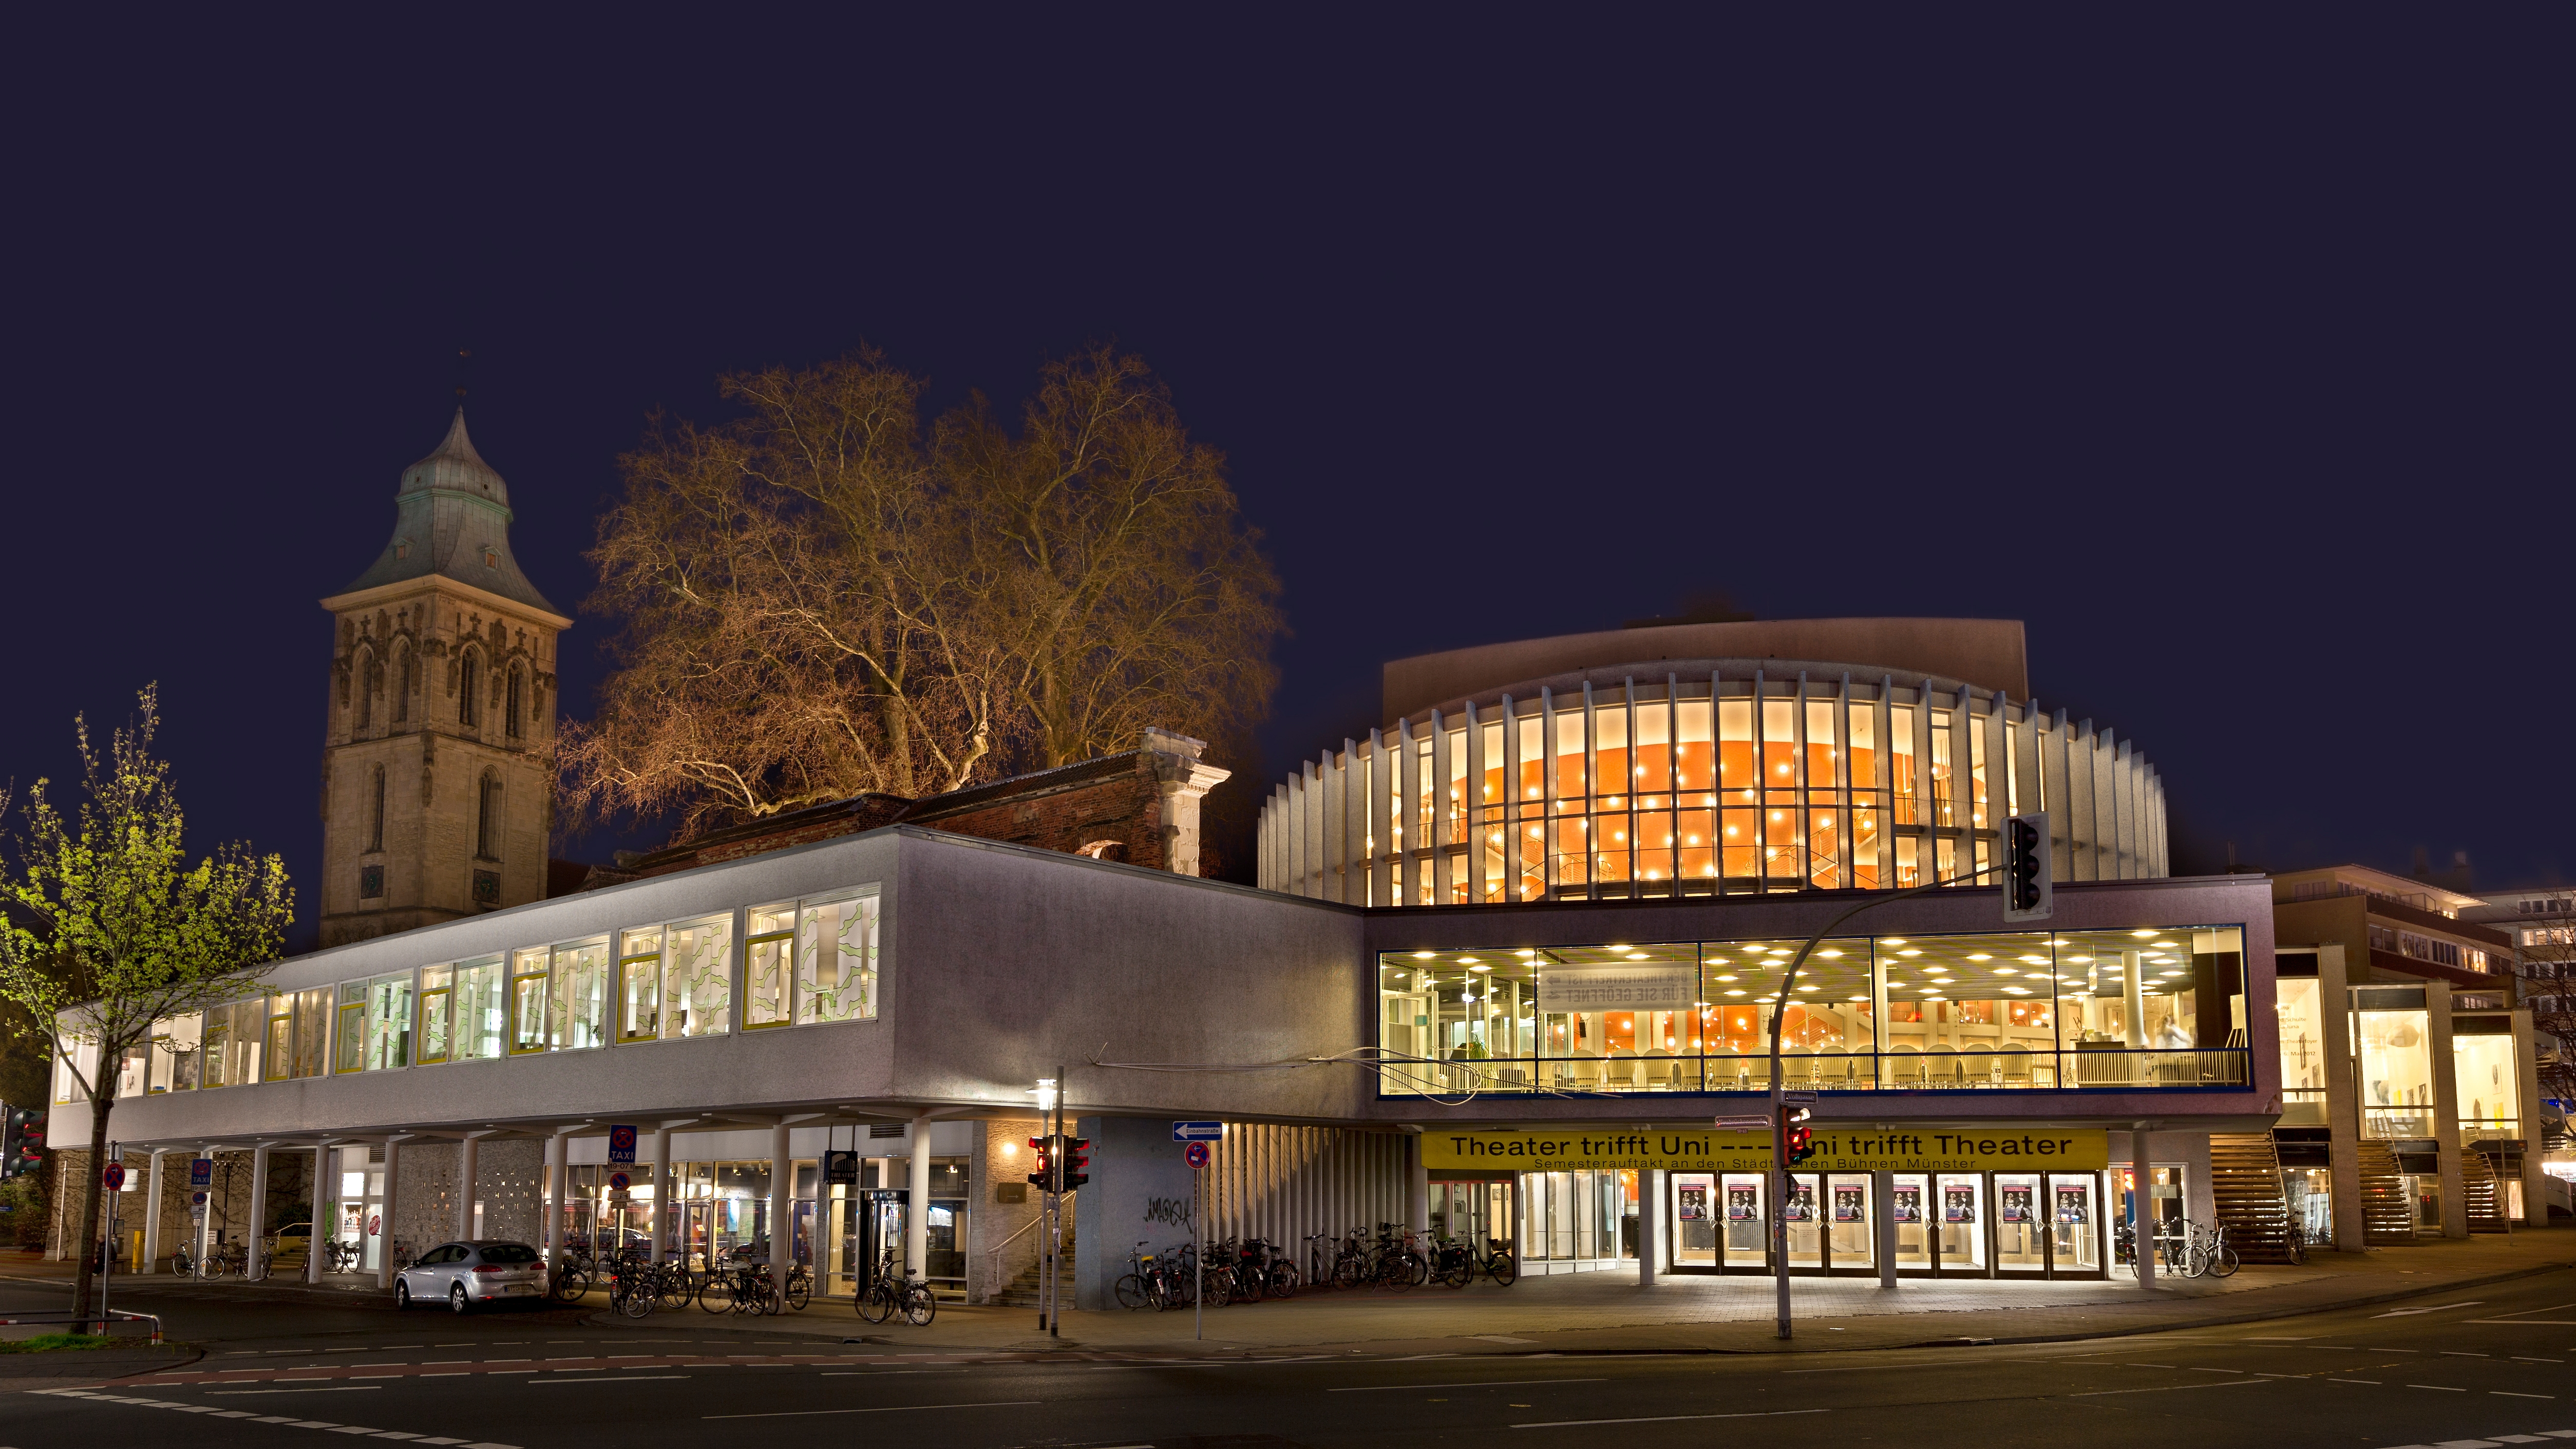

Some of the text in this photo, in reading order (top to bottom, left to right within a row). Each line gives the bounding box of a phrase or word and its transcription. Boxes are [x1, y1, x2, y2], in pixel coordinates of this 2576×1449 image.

[1450, 1137, 1570, 1156] Theater
[1580, 1136, 1649, 1155] trifft
[1661, 1136, 1709, 1155] Uni
[1849, 1135, 1923, 1155] trifft
[1934, 1135, 2072, 1155] Theater
[611, 1151, 633, 1160] TAXI
[1535, 1158, 1976, 1169] Semesterauftakt an den Städthen Bühnen Münster
